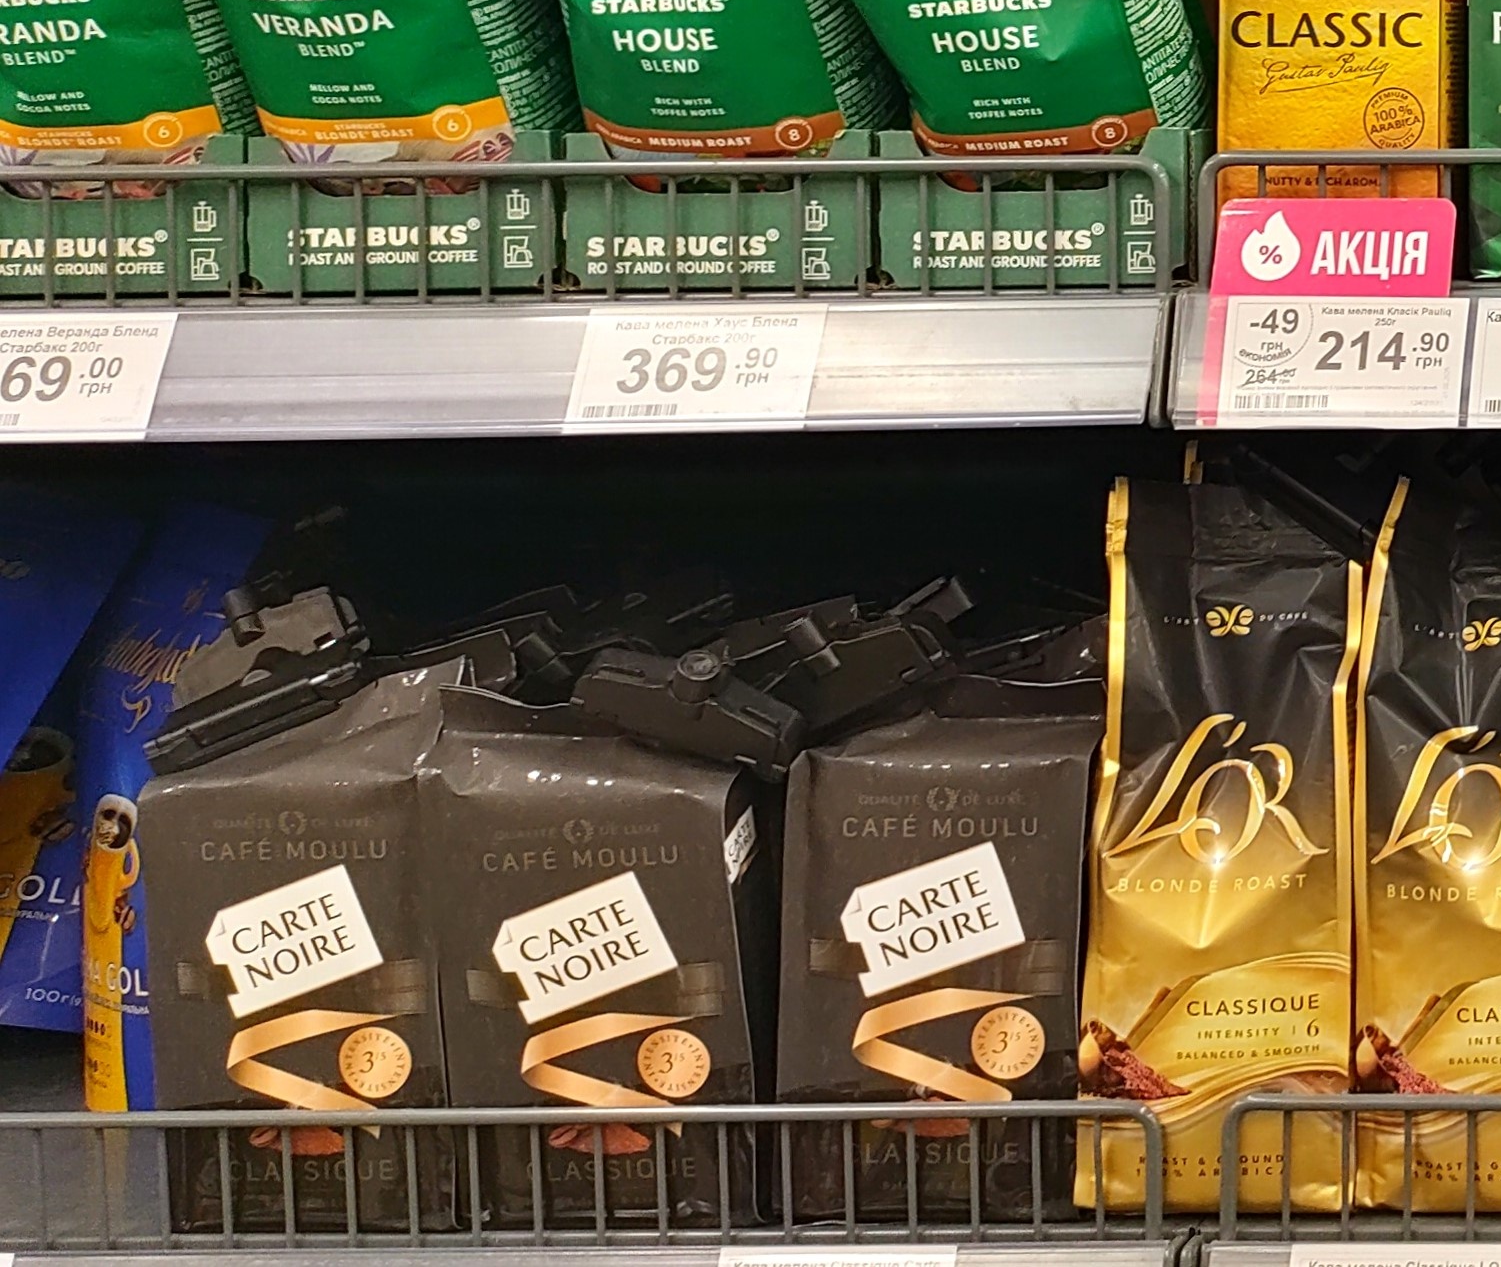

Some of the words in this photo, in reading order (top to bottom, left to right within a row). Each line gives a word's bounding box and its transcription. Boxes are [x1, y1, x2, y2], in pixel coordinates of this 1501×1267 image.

[253, 10, 394, 37] VERANDA
[1231, 11, 1424, 49] CLASSIC
[613, 27, 718, 52] HOUSE
[932, 25, 1039, 53] HOUSE
[641, 58, 700, 74] BLEND
[649, 136, 700, 148] MEDIUM
[704, 135, 752, 147] ROAST
[1310, 231, 1428, 277] АКЦІЯ
[47, 326, 108, 340] Веранда
[113, 326, 158, 337] Бленд
[1250, 309, 1299, 334] -49
[1315, 331, 1407, 370] 214
[1416, 358, 1442, 369] грн
[617, 347, 727, 393] 369
[842, 813, 917, 838] CAFÉ
[932, 817, 1039, 837] MOULU
[1117, 878, 1220, 894] BLONDE
[1233, 873, 1308, 892] ROAST
[867, 869, 989, 934] CARTE
[231, 892, 343, 956] CARTE
[878, 902, 1000, 967] NOIRE
[244, 925, 357, 990] NOIRE
[1185, 991, 1321, 1018] CLASSIQUE
[1197, 1026, 1281, 1040] INTENSITY
